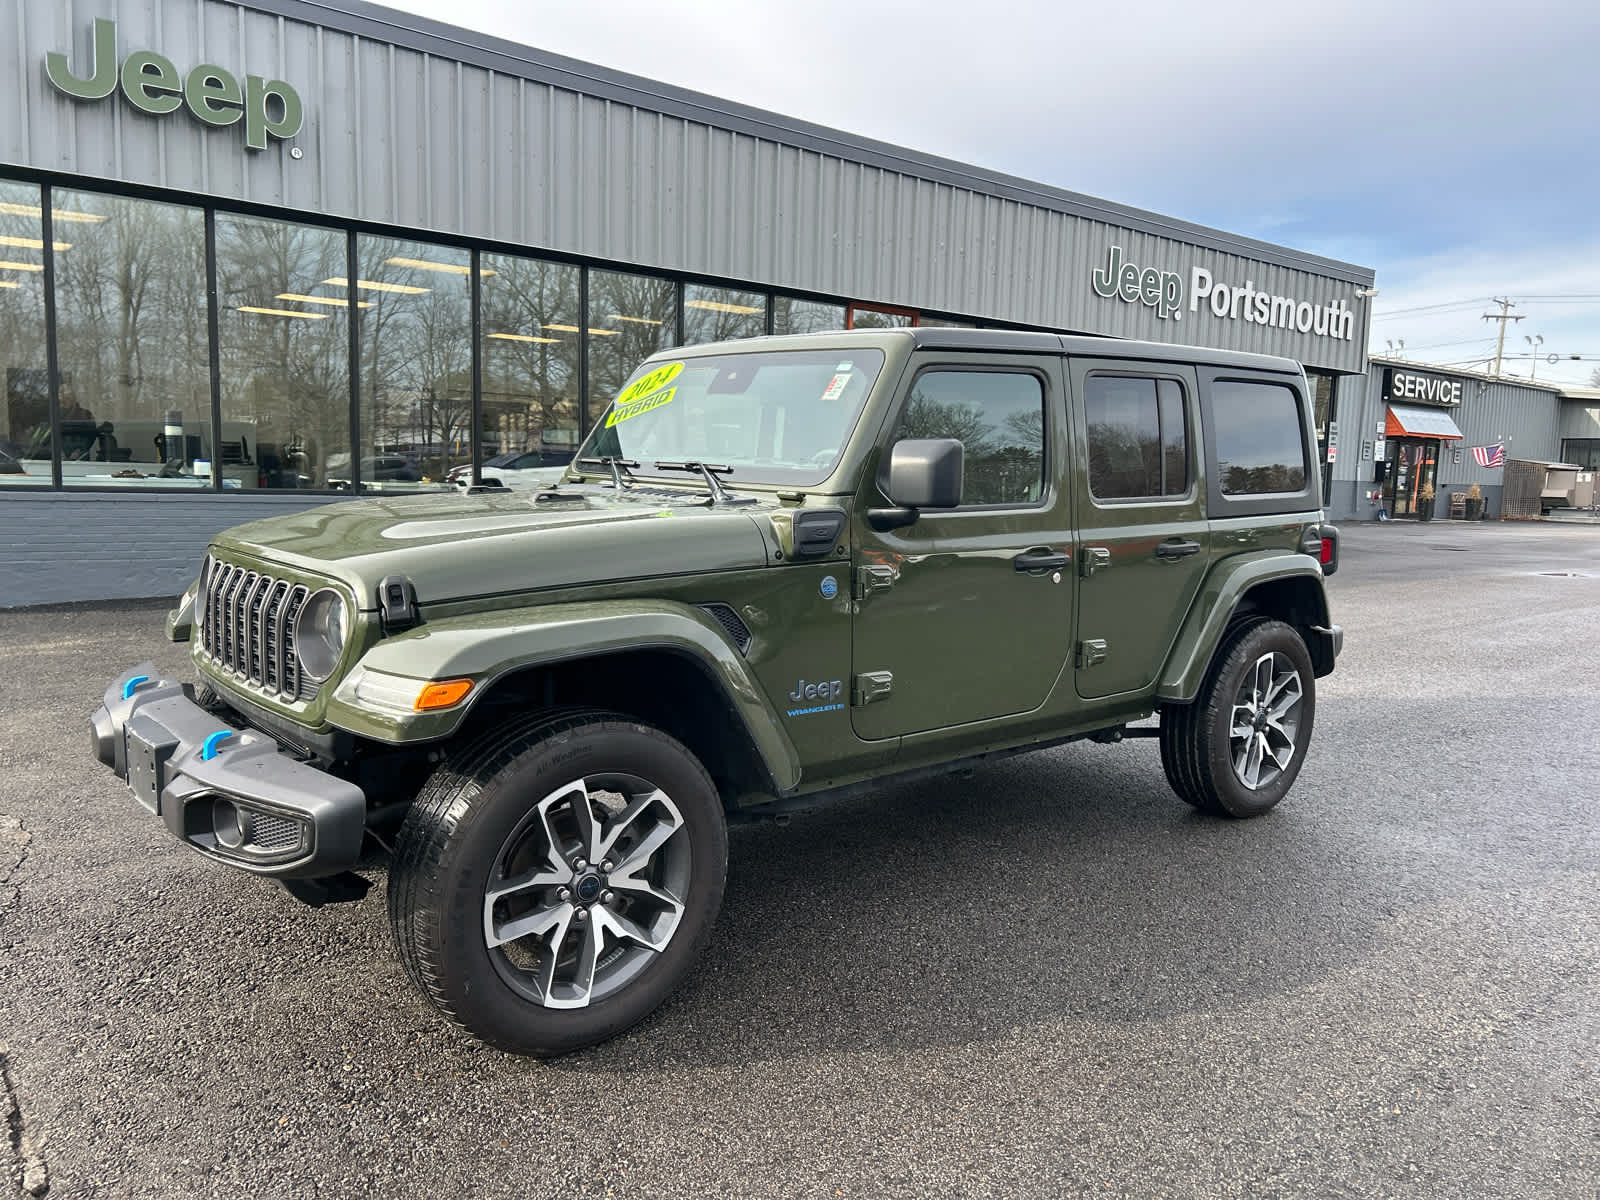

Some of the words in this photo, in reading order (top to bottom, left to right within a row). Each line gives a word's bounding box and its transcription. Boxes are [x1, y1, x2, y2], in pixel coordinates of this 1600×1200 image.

[45, 16, 304, 150] Jeep
[1092, 245, 1183, 319] Jeep
[1190, 266, 1354, 341] Portsmouth
[623, 364, 677, 403] 2024
[1393, 373, 1461, 404] SERVICE
[609, 390, 672, 425] HYBRID
[789, 679, 843, 703] Jeep
